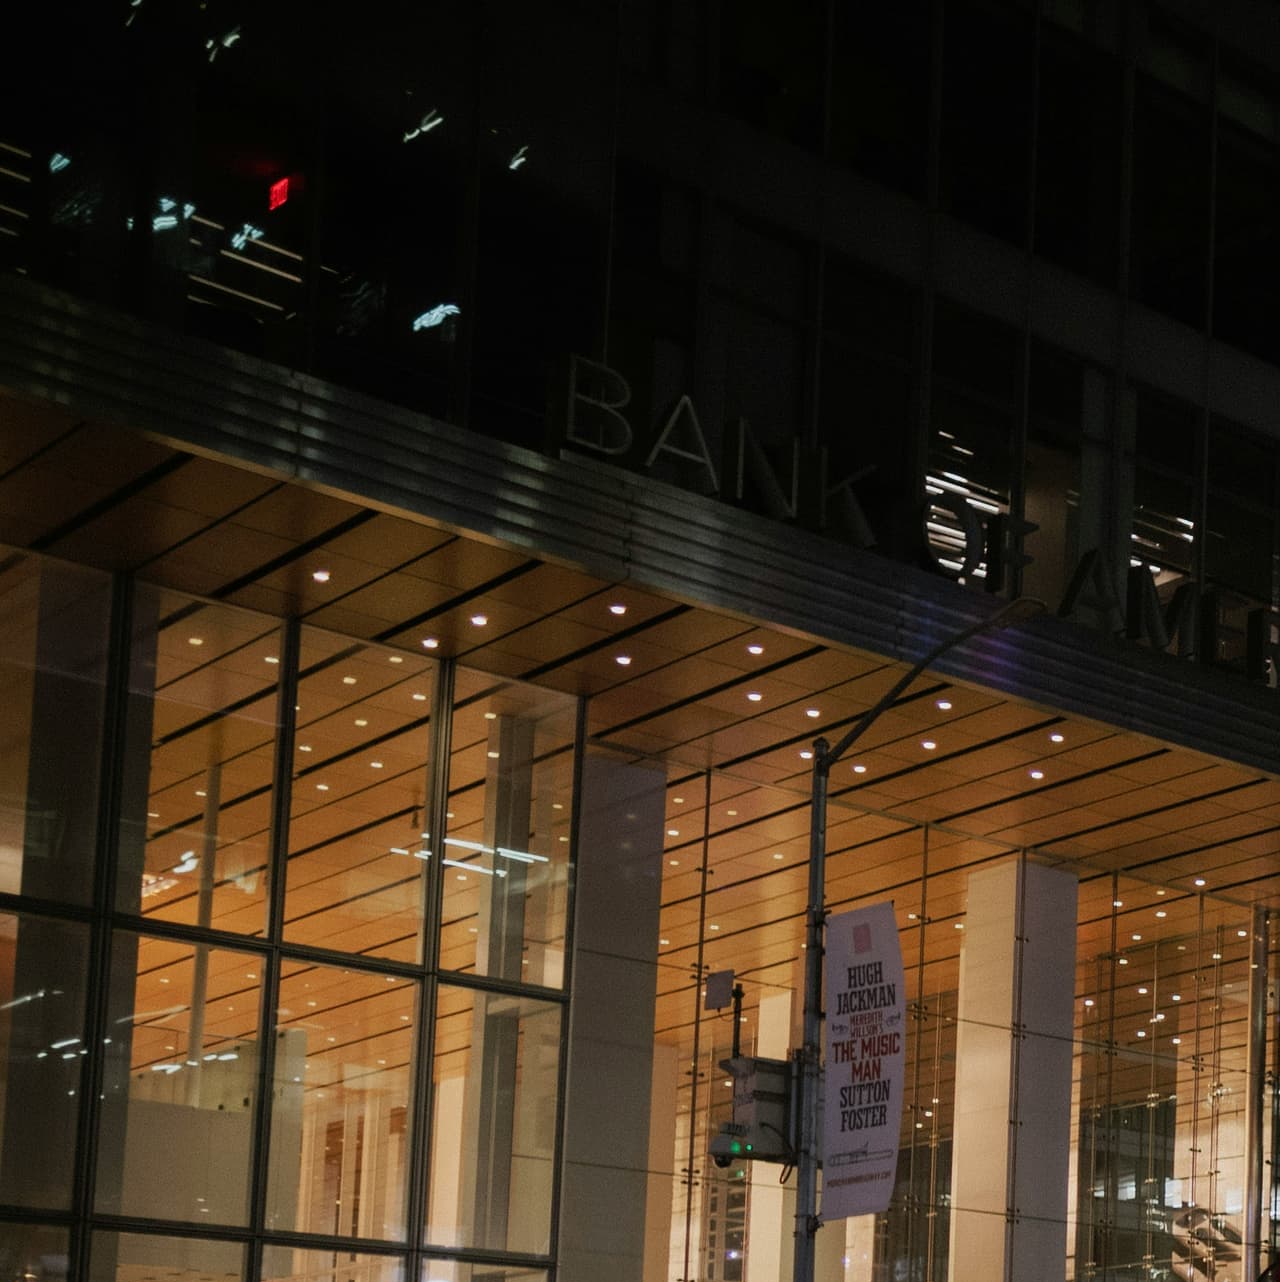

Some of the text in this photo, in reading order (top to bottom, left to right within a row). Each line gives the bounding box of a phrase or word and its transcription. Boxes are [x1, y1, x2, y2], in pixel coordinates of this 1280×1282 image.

[567, 353, 878, 549] BANK
[922, 490, 1040, 600] OF
[847, 961, 883, 989] HUGH
[836, 984, 896, 1016] JACKMAN
[832, 1032, 901, 1064] THE MUSIC
[851, 1059, 881, 1084] MAN
[839, 1080, 891, 1109] SUTTON
[840, 1106, 887, 1132] FOSTER
